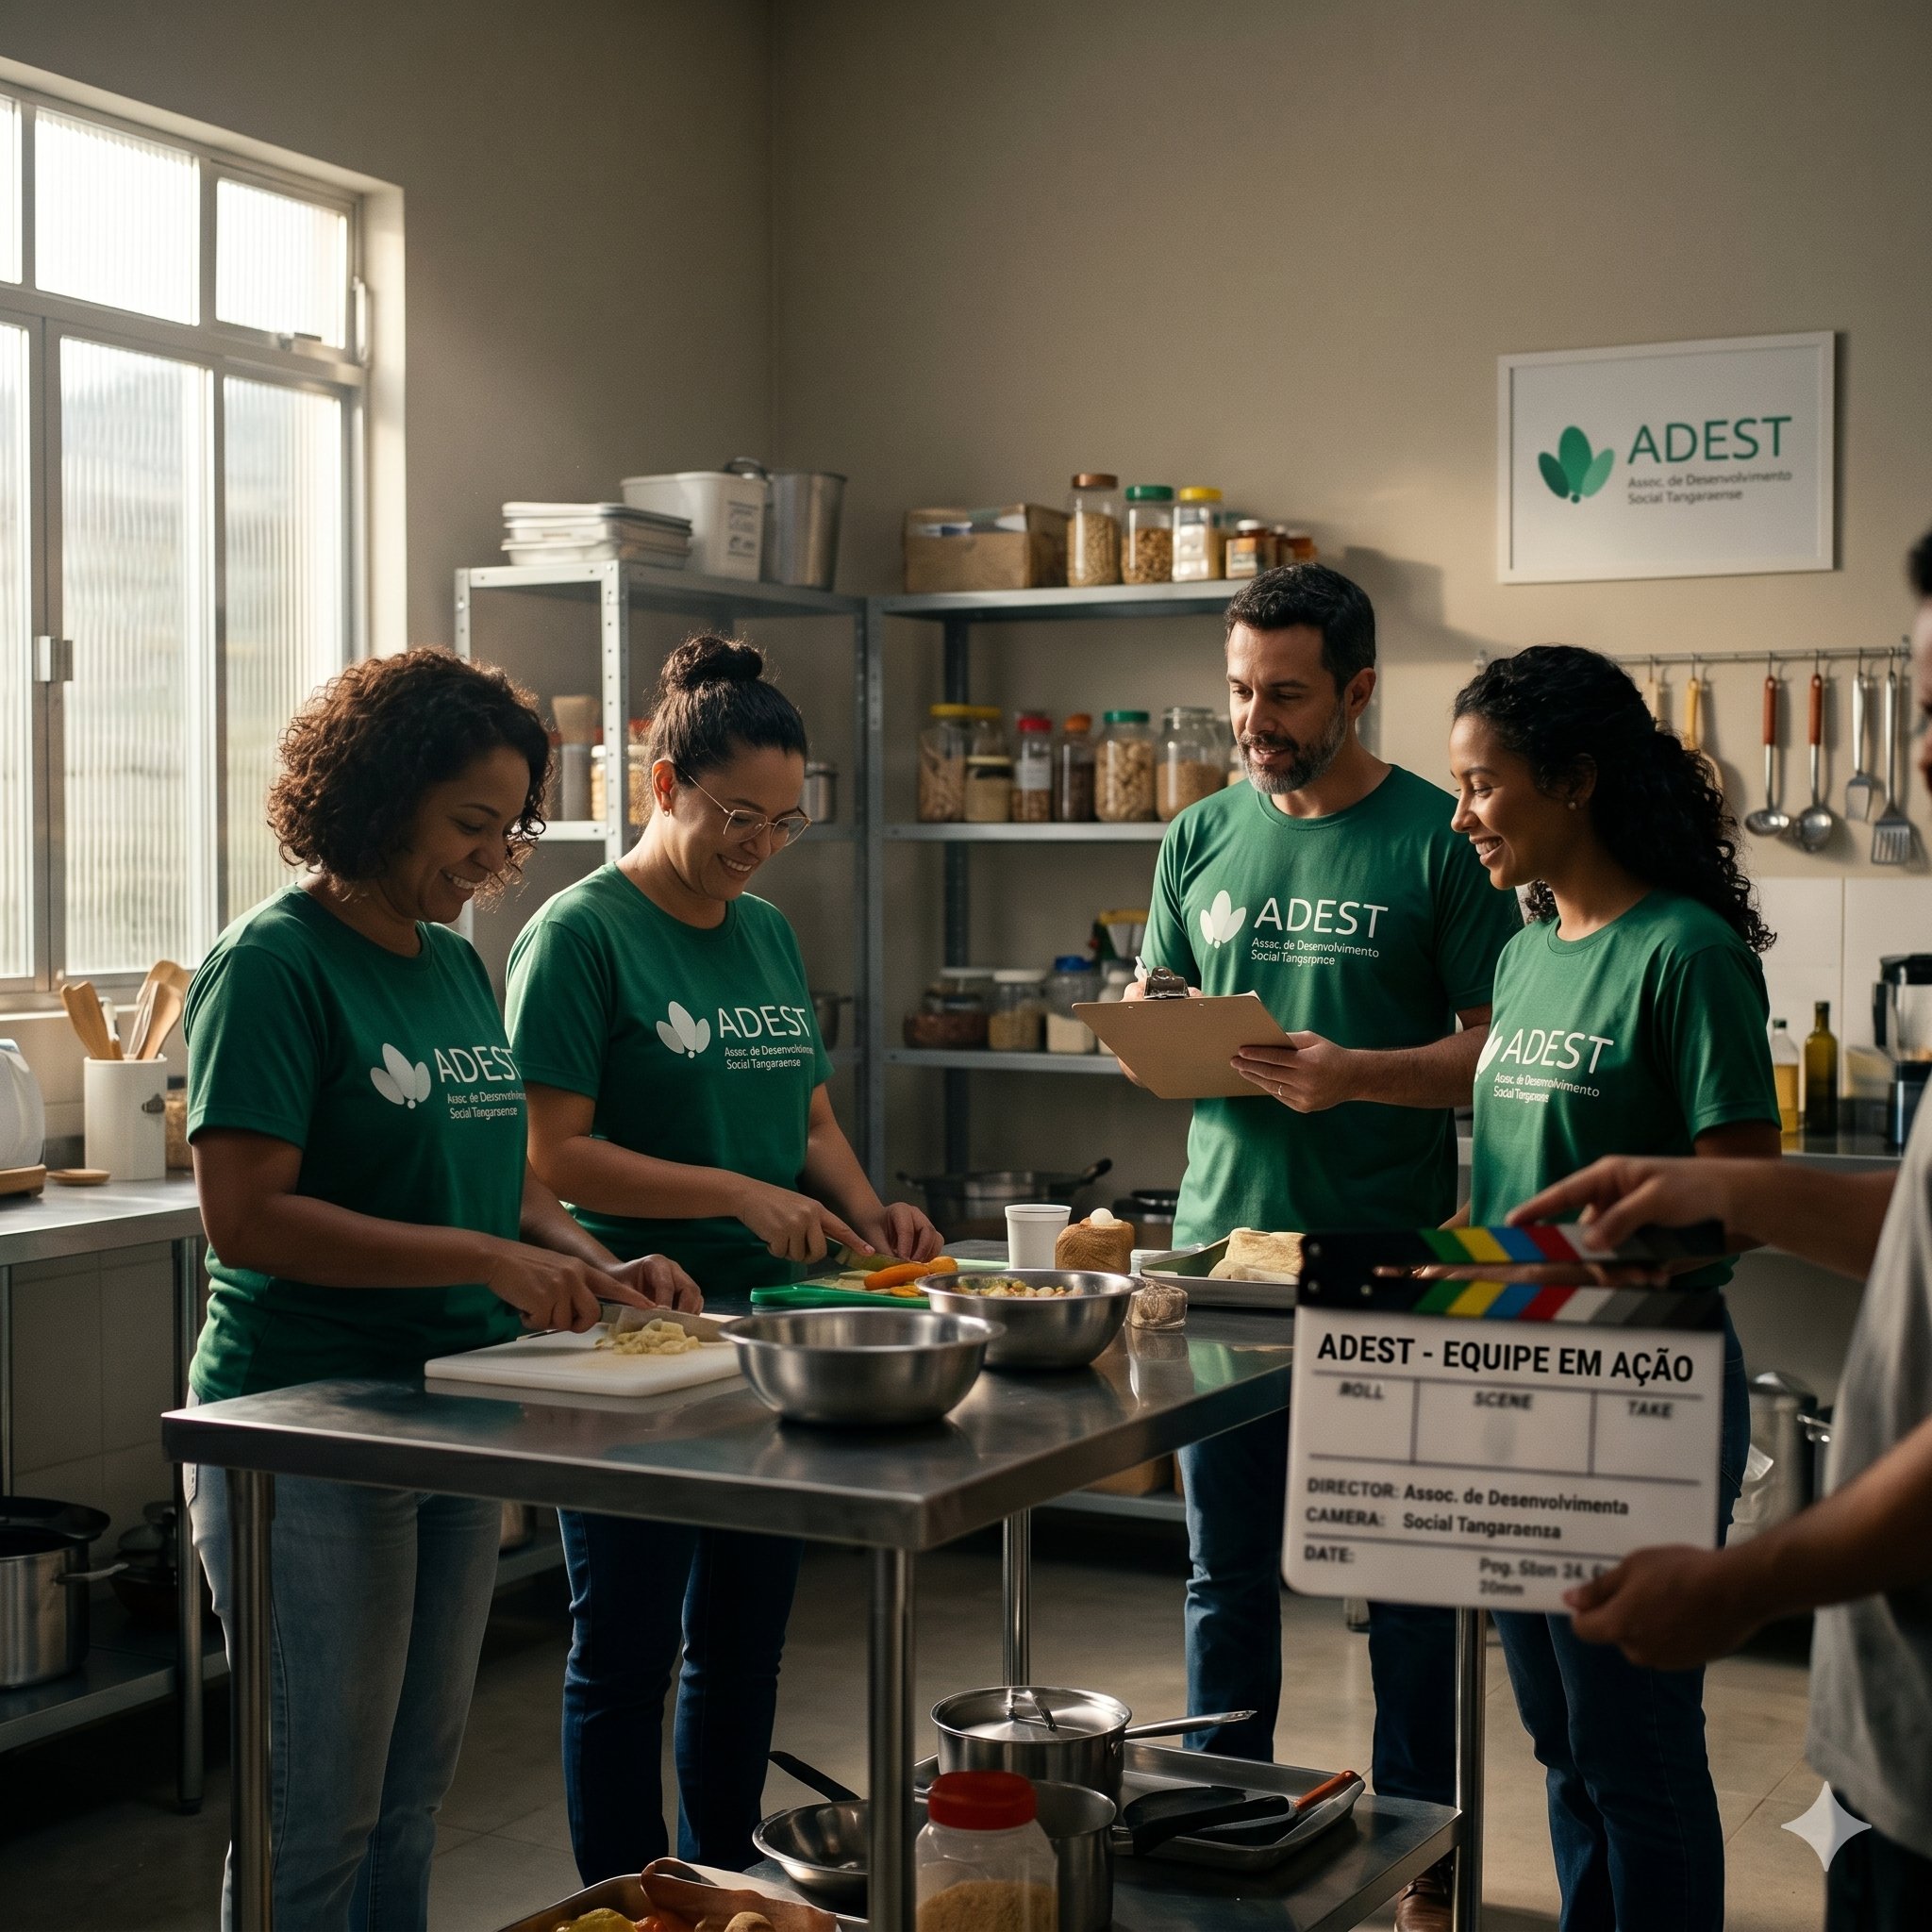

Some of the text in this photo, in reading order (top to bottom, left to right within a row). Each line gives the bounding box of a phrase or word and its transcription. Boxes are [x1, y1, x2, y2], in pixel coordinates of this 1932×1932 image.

[1626, 416, 1791, 465] ADEST
[1668, 475, 1683, 487] de
[1627, 491, 1663, 505] Social
[1254, 897, 1389, 939] ADEST
[1251, 949, 1279, 961] Social
[1284, 940, 1295, 950] de
[1297, 940, 1379, 958] Desenvolvimento
[717, 1006, 810, 1038] ADEST
[750, 1045, 760, 1056] de
[1500, 1028, 1614, 1074] ADEST
[434, 1046, 523, 1083] ADEST
[751, 1058, 801, 1071] Tangaraense
[1317, 1333, 1416, 1365] ADEST
[1442, 1341, 1550, 1374] EQUIPE
[1558, 1347, 1603, 1377] EM
[1609, 1348, 1694, 1387] AÇÃO
[1339, 1381, 1385, 1400] ROLL
[1474, 1391, 1534, 1410] SCENE
[1627, 1400, 1674, 1420] TAKE
[1307, 1477, 1400, 1499] DIRECTOR:
[1404, 1484, 1459, 1504] Assoc.
[1463, 1488, 1484, 1505] de
[1306, 1507, 1386, 1527] CAMERA:
[1403, 1512, 1454, 1533] Social
[1304, 1544, 1356, 1564] DATE:
